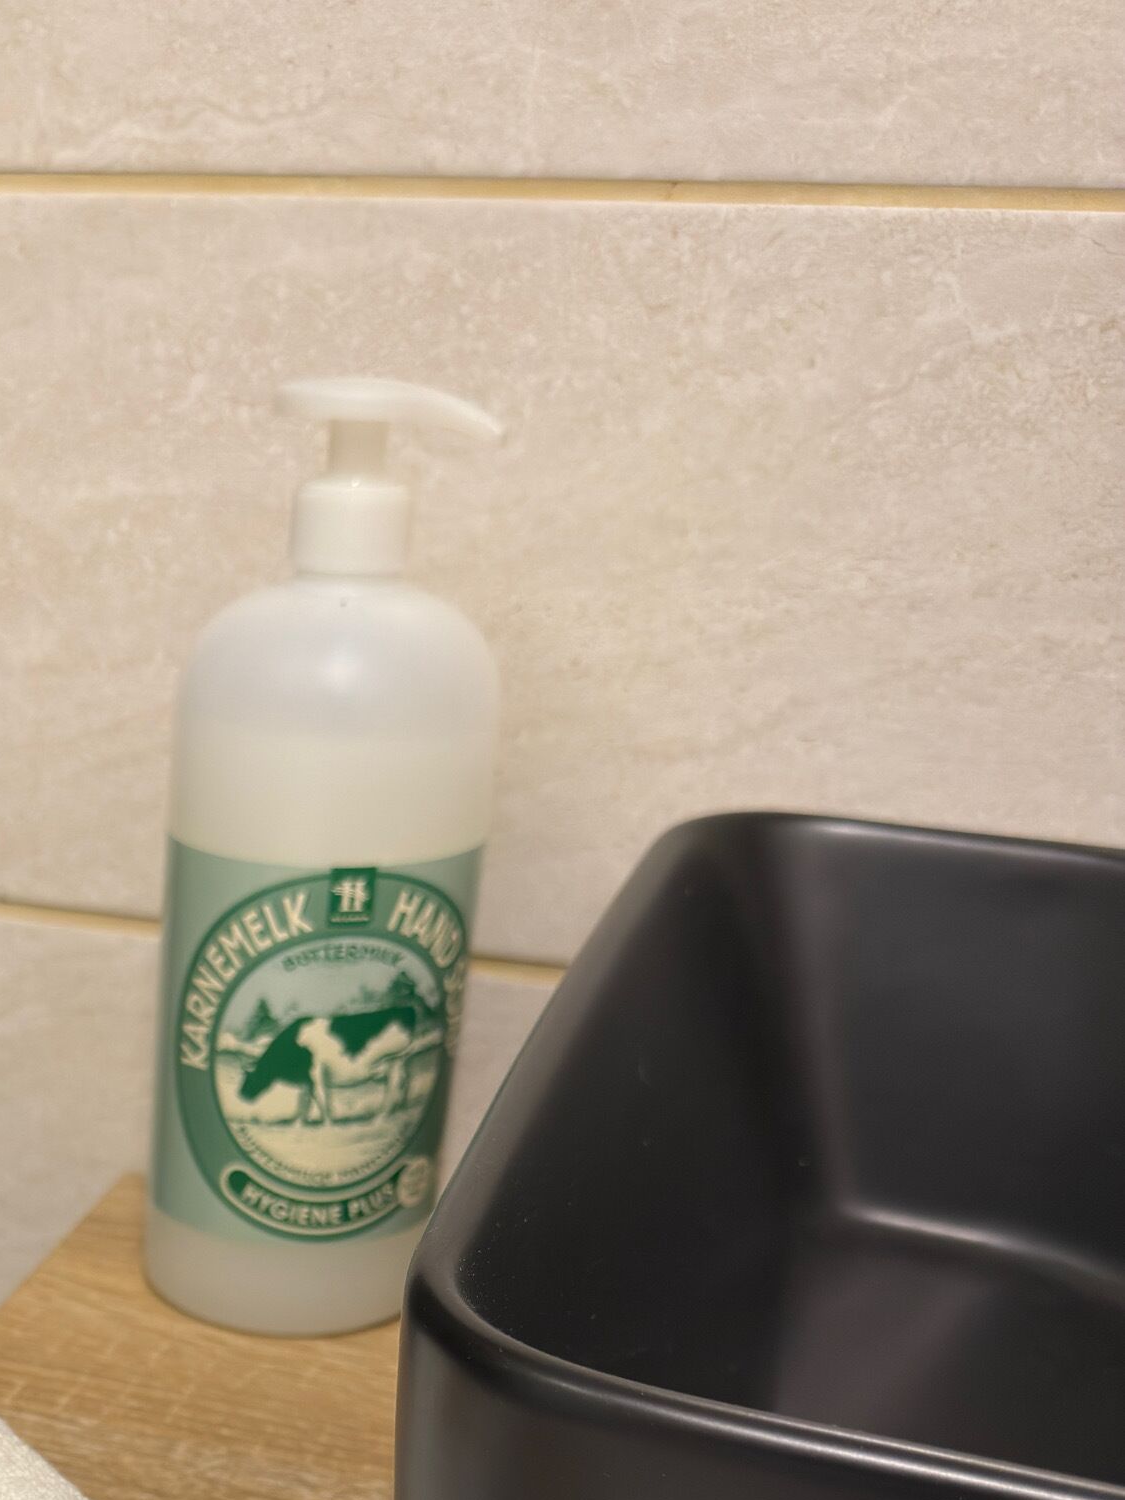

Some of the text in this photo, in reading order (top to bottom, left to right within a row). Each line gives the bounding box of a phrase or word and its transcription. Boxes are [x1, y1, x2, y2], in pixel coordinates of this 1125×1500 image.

[179, 890, 314, 1071] KARNEMELK
[386, 890, 461, 969] HAND
[242, 1181, 342, 1226] HYGIENE
